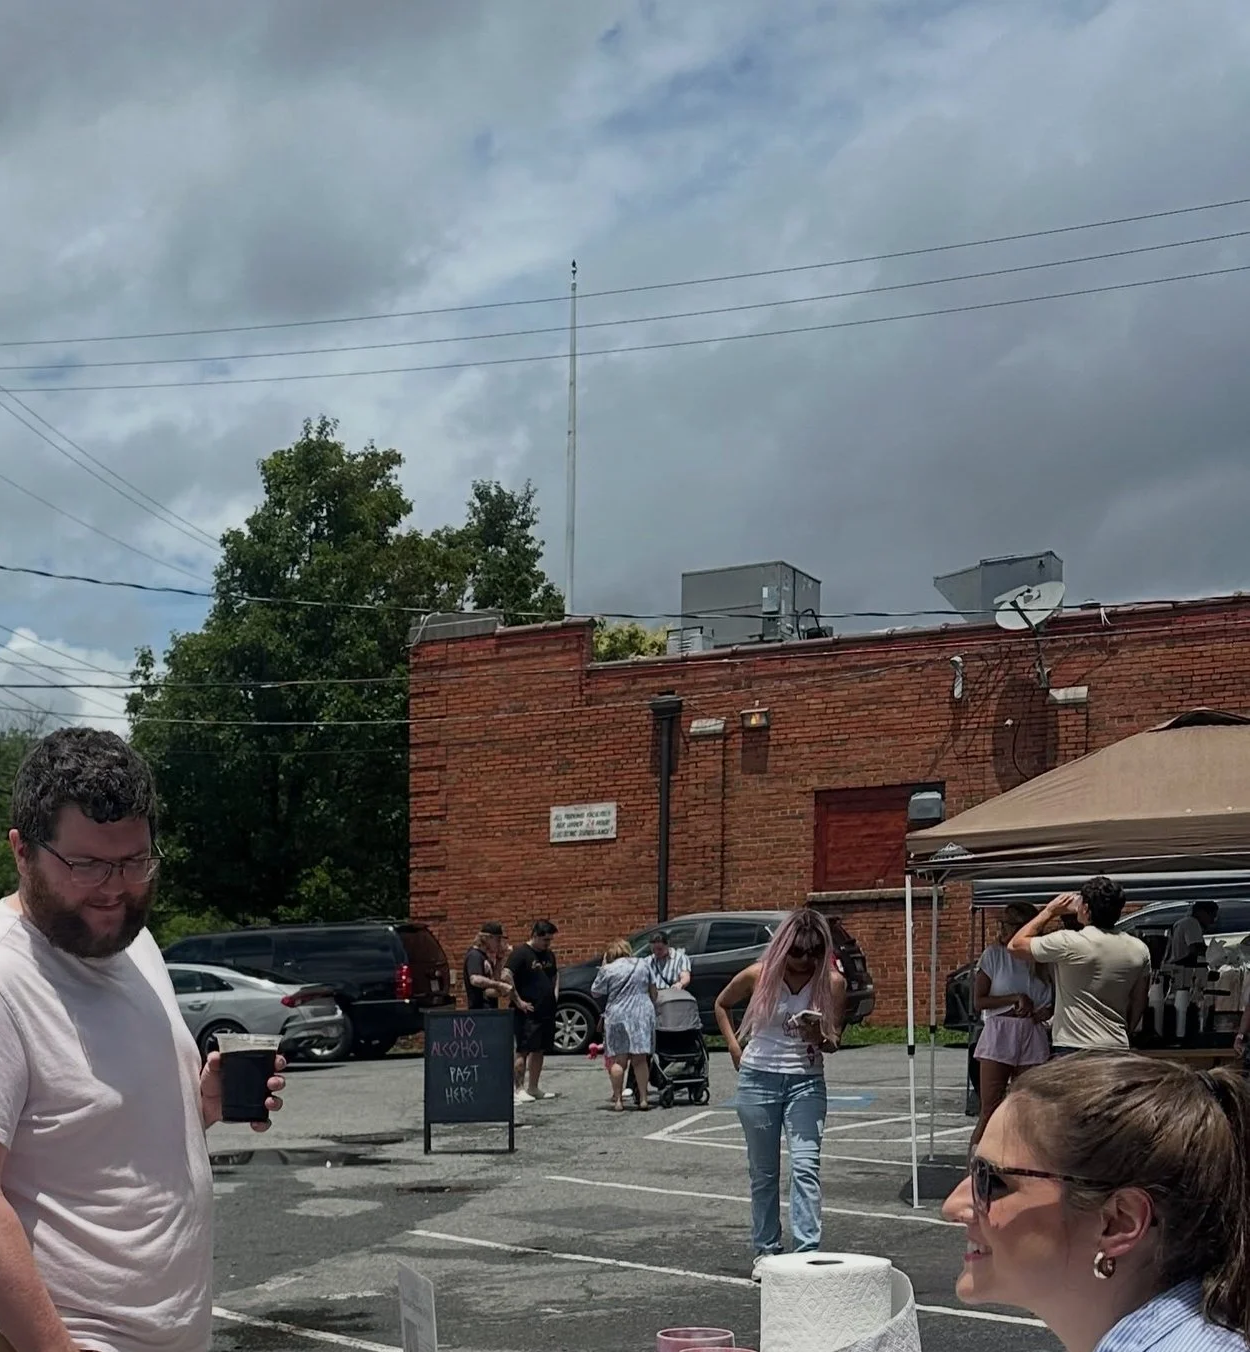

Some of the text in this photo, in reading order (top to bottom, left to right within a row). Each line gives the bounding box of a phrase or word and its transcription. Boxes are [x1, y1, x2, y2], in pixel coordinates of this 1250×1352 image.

[586, 818, 595, 828] 24
[453, 1017, 476, 1037] NO
[431, 1040, 489, 1059] ALCOHOL
[449, 1064, 480, 1084] PAST
[445, 1086, 474, 1105] HERE
